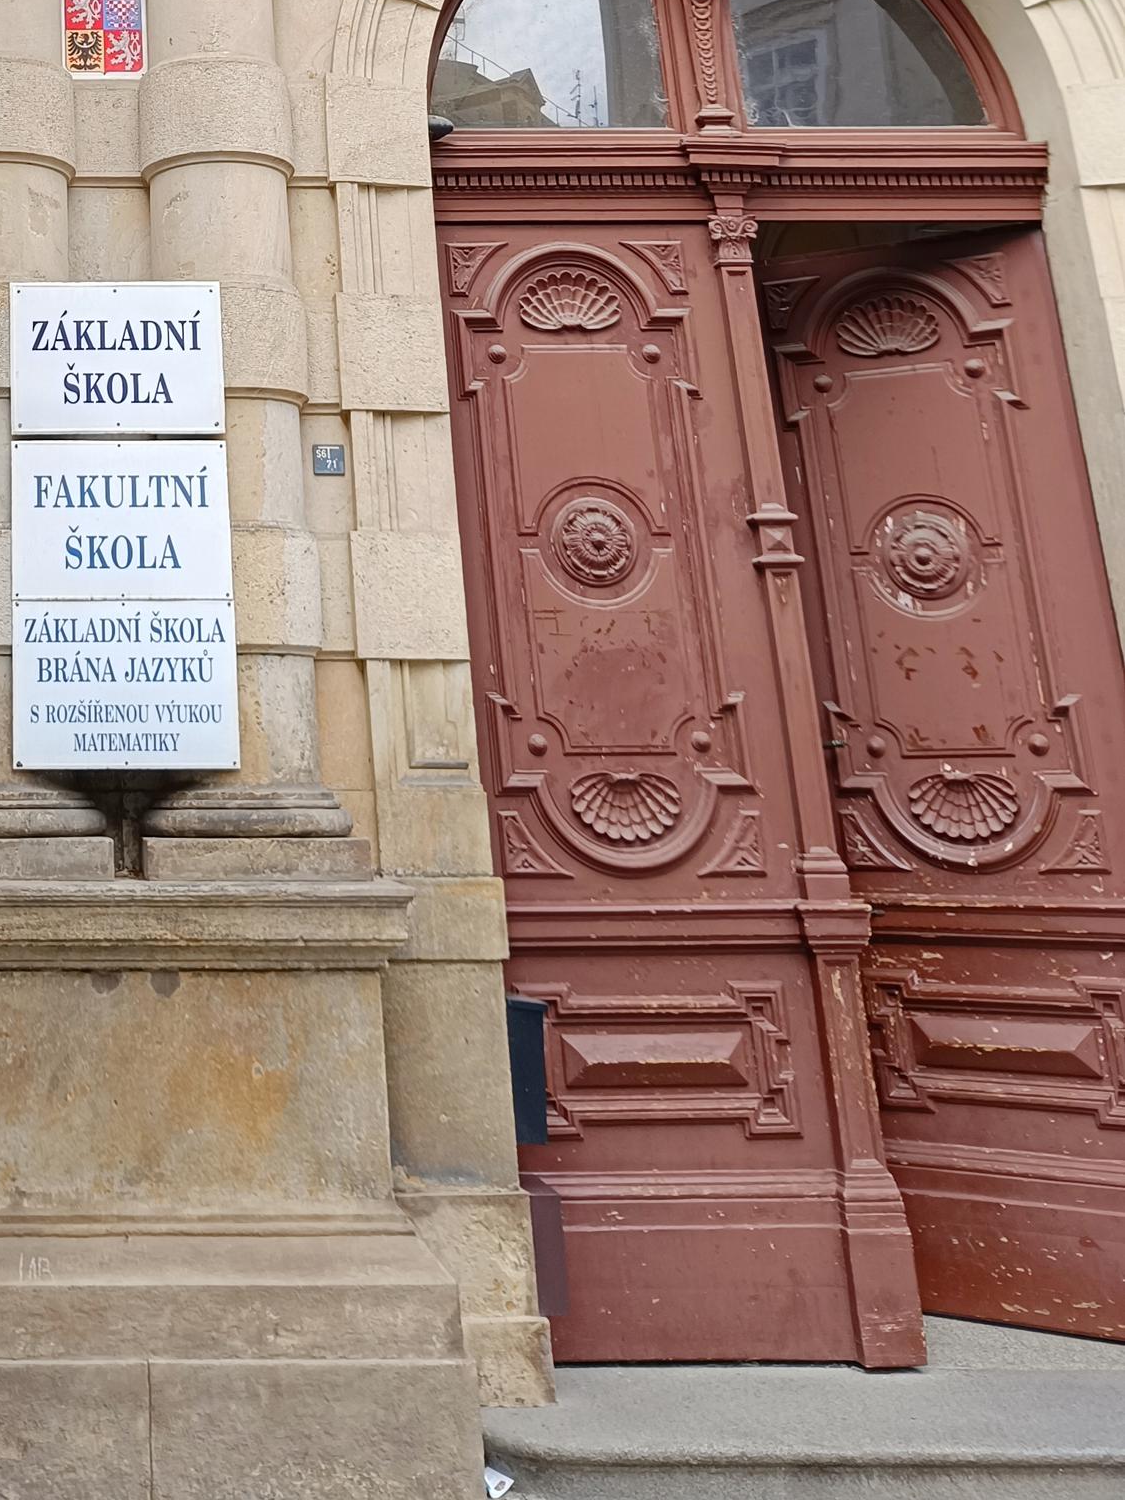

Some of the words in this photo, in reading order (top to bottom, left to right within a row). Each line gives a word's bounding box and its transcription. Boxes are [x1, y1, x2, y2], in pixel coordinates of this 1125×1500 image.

[31, 310, 202, 351] ZÁKLADNÍ
[63, 362, 174, 405] ŠKOLA
[33, 465, 210, 509] FAKULTNÍ
[65, 525, 182, 570] ŠKOLA
[24, 612, 142, 643] ZÁKLADNÍ
[149, 611, 226, 643] ŠKOLA
[36, 650, 117, 683] BRÁNA
[124, 649, 214, 683] JAZYKŮ
[30, 704, 40, 724] S
[45, 699, 150, 724] ROZŠÍŘENOU
[154, 700, 223, 724] VÝUKOU
[73, 732, 181, 752] MATEMATIKY
